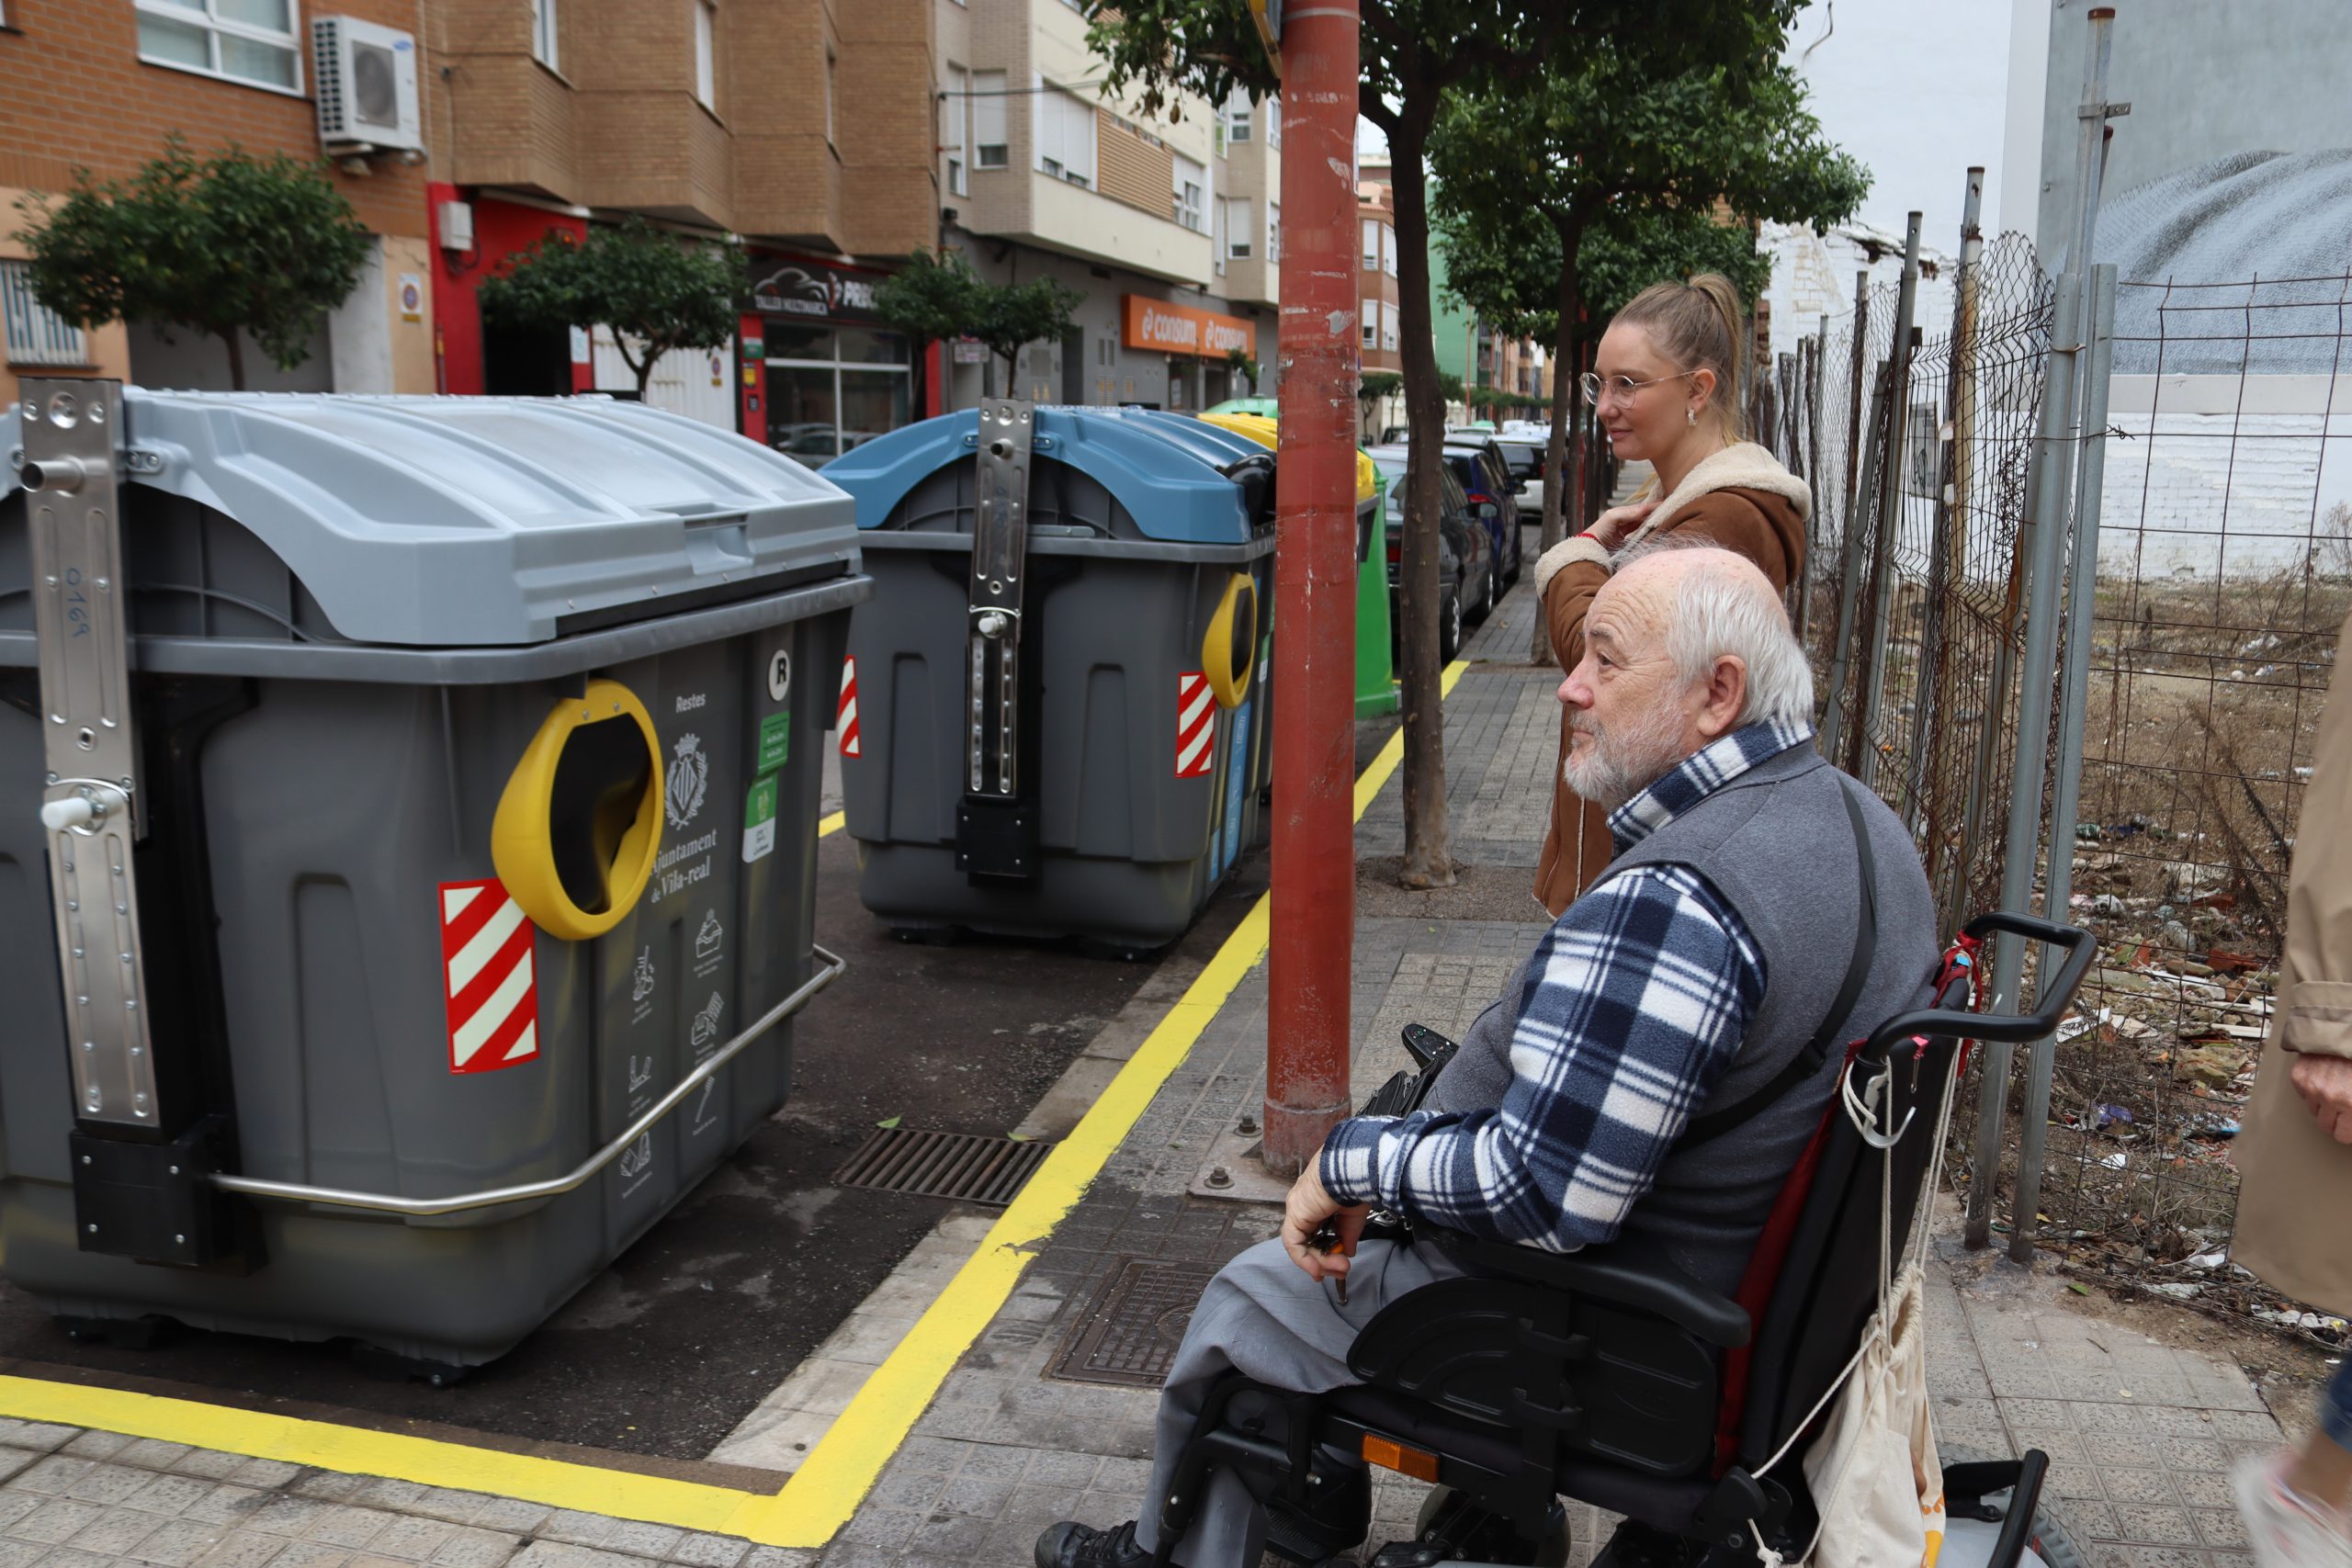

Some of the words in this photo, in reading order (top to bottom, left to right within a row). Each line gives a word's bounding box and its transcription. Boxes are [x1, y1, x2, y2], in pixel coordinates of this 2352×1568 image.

[1154, 313, 1196, 345] consum
[776, 658, 786, 684] R
[675, 693, 707, 714] Restes
[662, 855, 711, 897] Vila-real
